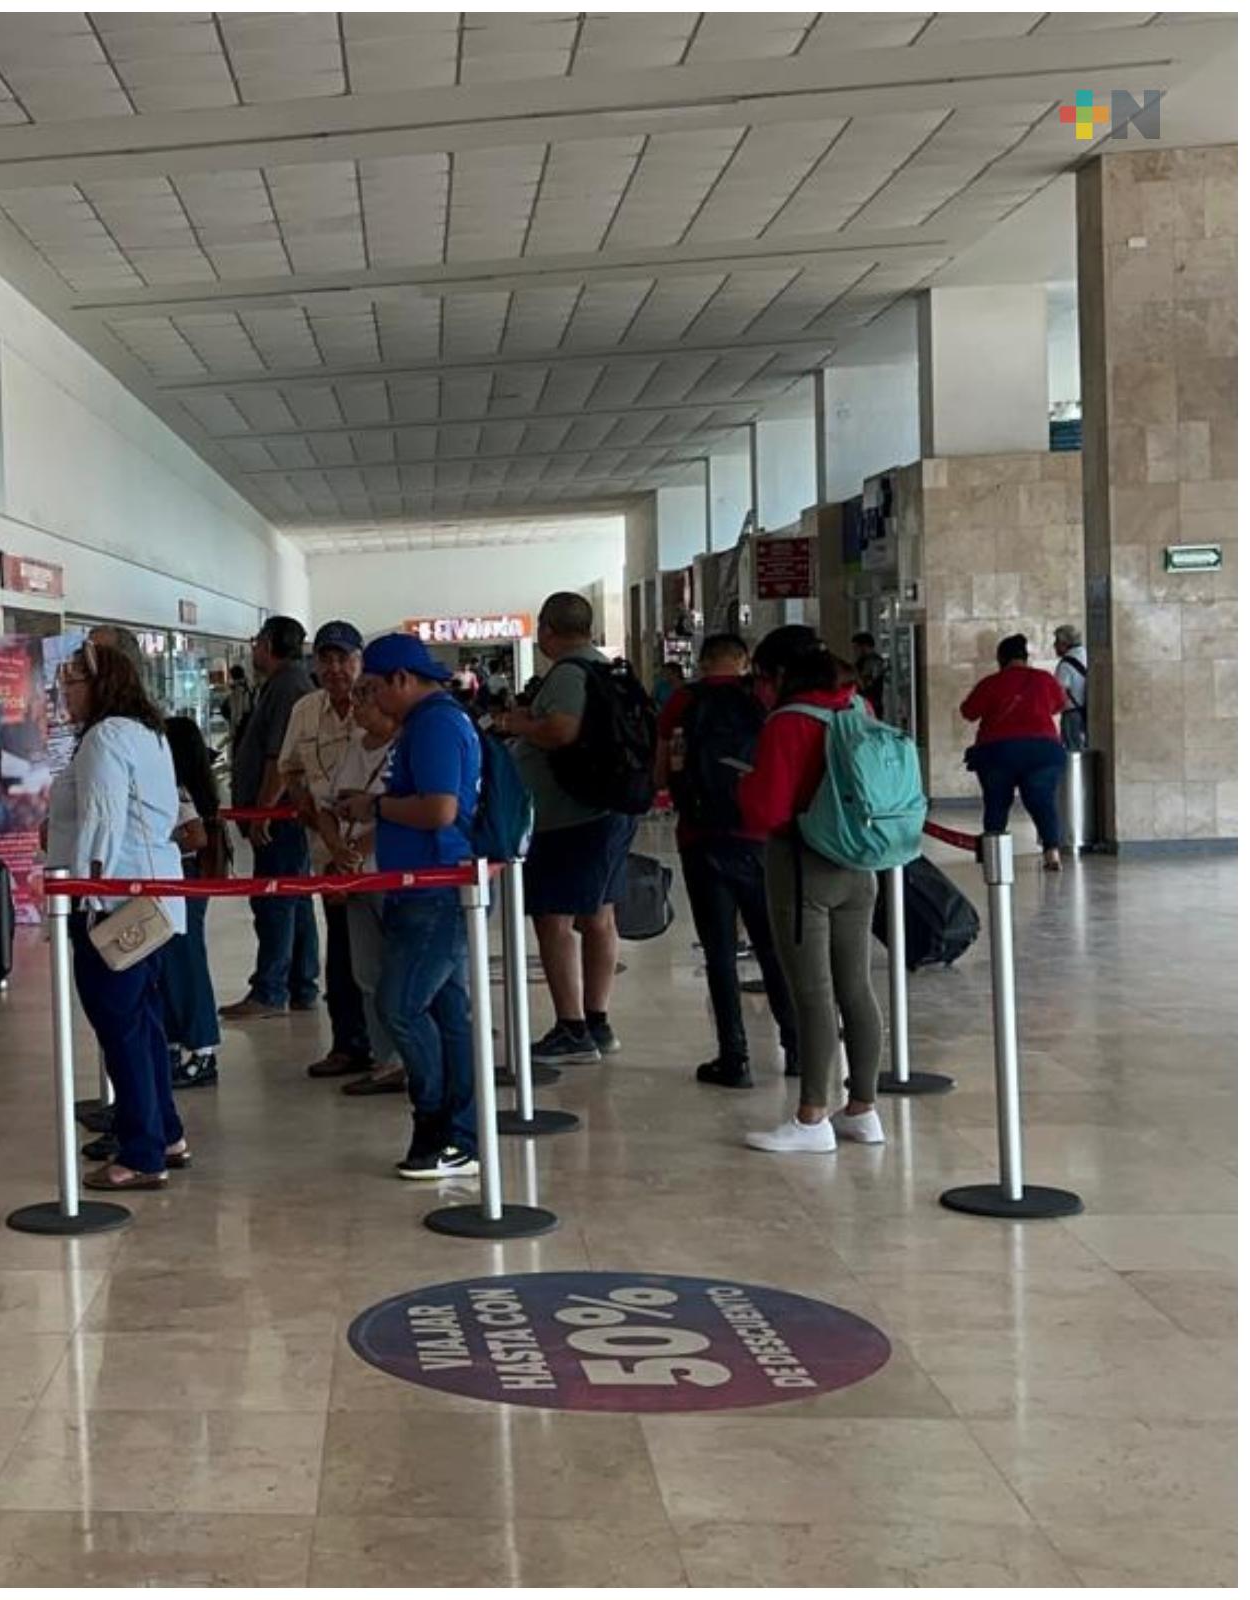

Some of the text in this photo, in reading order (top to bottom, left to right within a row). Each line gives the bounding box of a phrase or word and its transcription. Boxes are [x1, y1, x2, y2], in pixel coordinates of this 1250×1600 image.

[407, 1304, 474, 1371] VIAJAR
[466, 1288, 557, 1390] HASTA CON
[554, 1286, 733, 1388] 50%
[763, 1366, 819, 1388] DE
